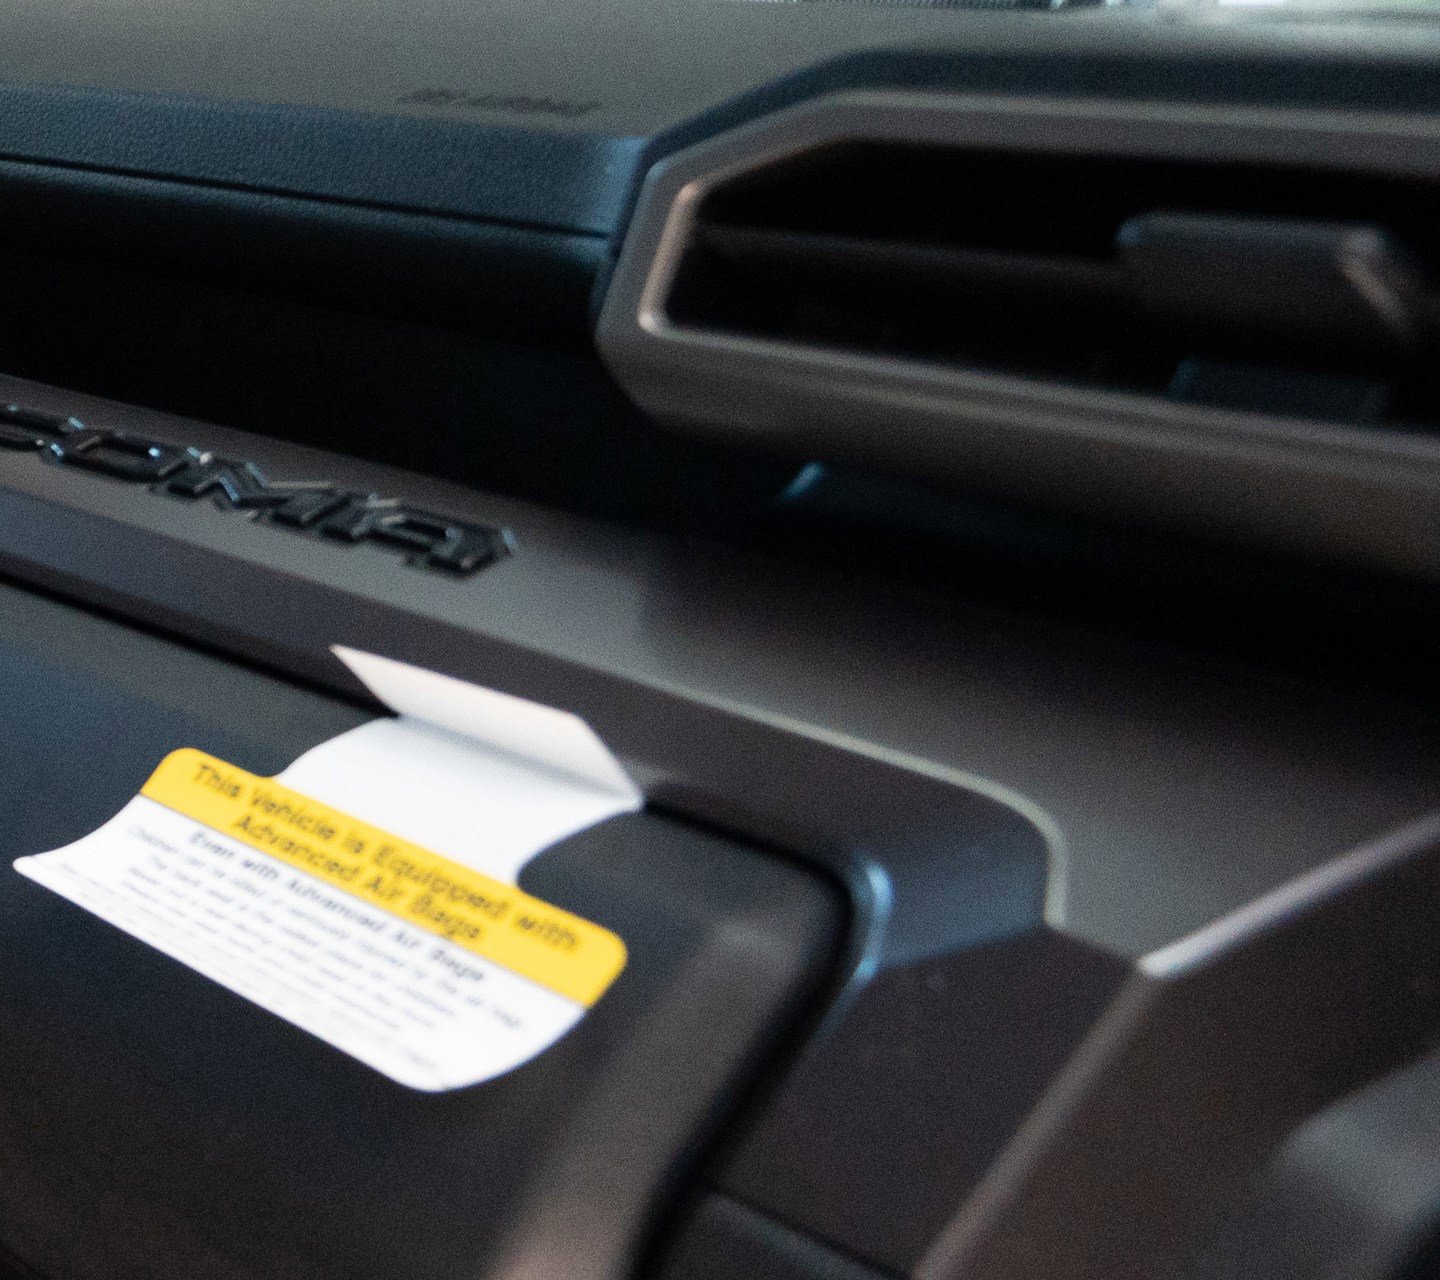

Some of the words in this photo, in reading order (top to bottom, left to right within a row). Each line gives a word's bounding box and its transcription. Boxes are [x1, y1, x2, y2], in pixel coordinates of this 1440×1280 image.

[194, 763, 242, 798] This
[251, 789, 337, 841] Vehicle
[343, 830, 367, 855] is
[375, 843, 511, 920] Equipped
[515, 913, 579, 951] with
[236, 814, 361, 882] Advanced
[365, 875, 405, 902] Air
[409, 893, 482, 940] Bags
